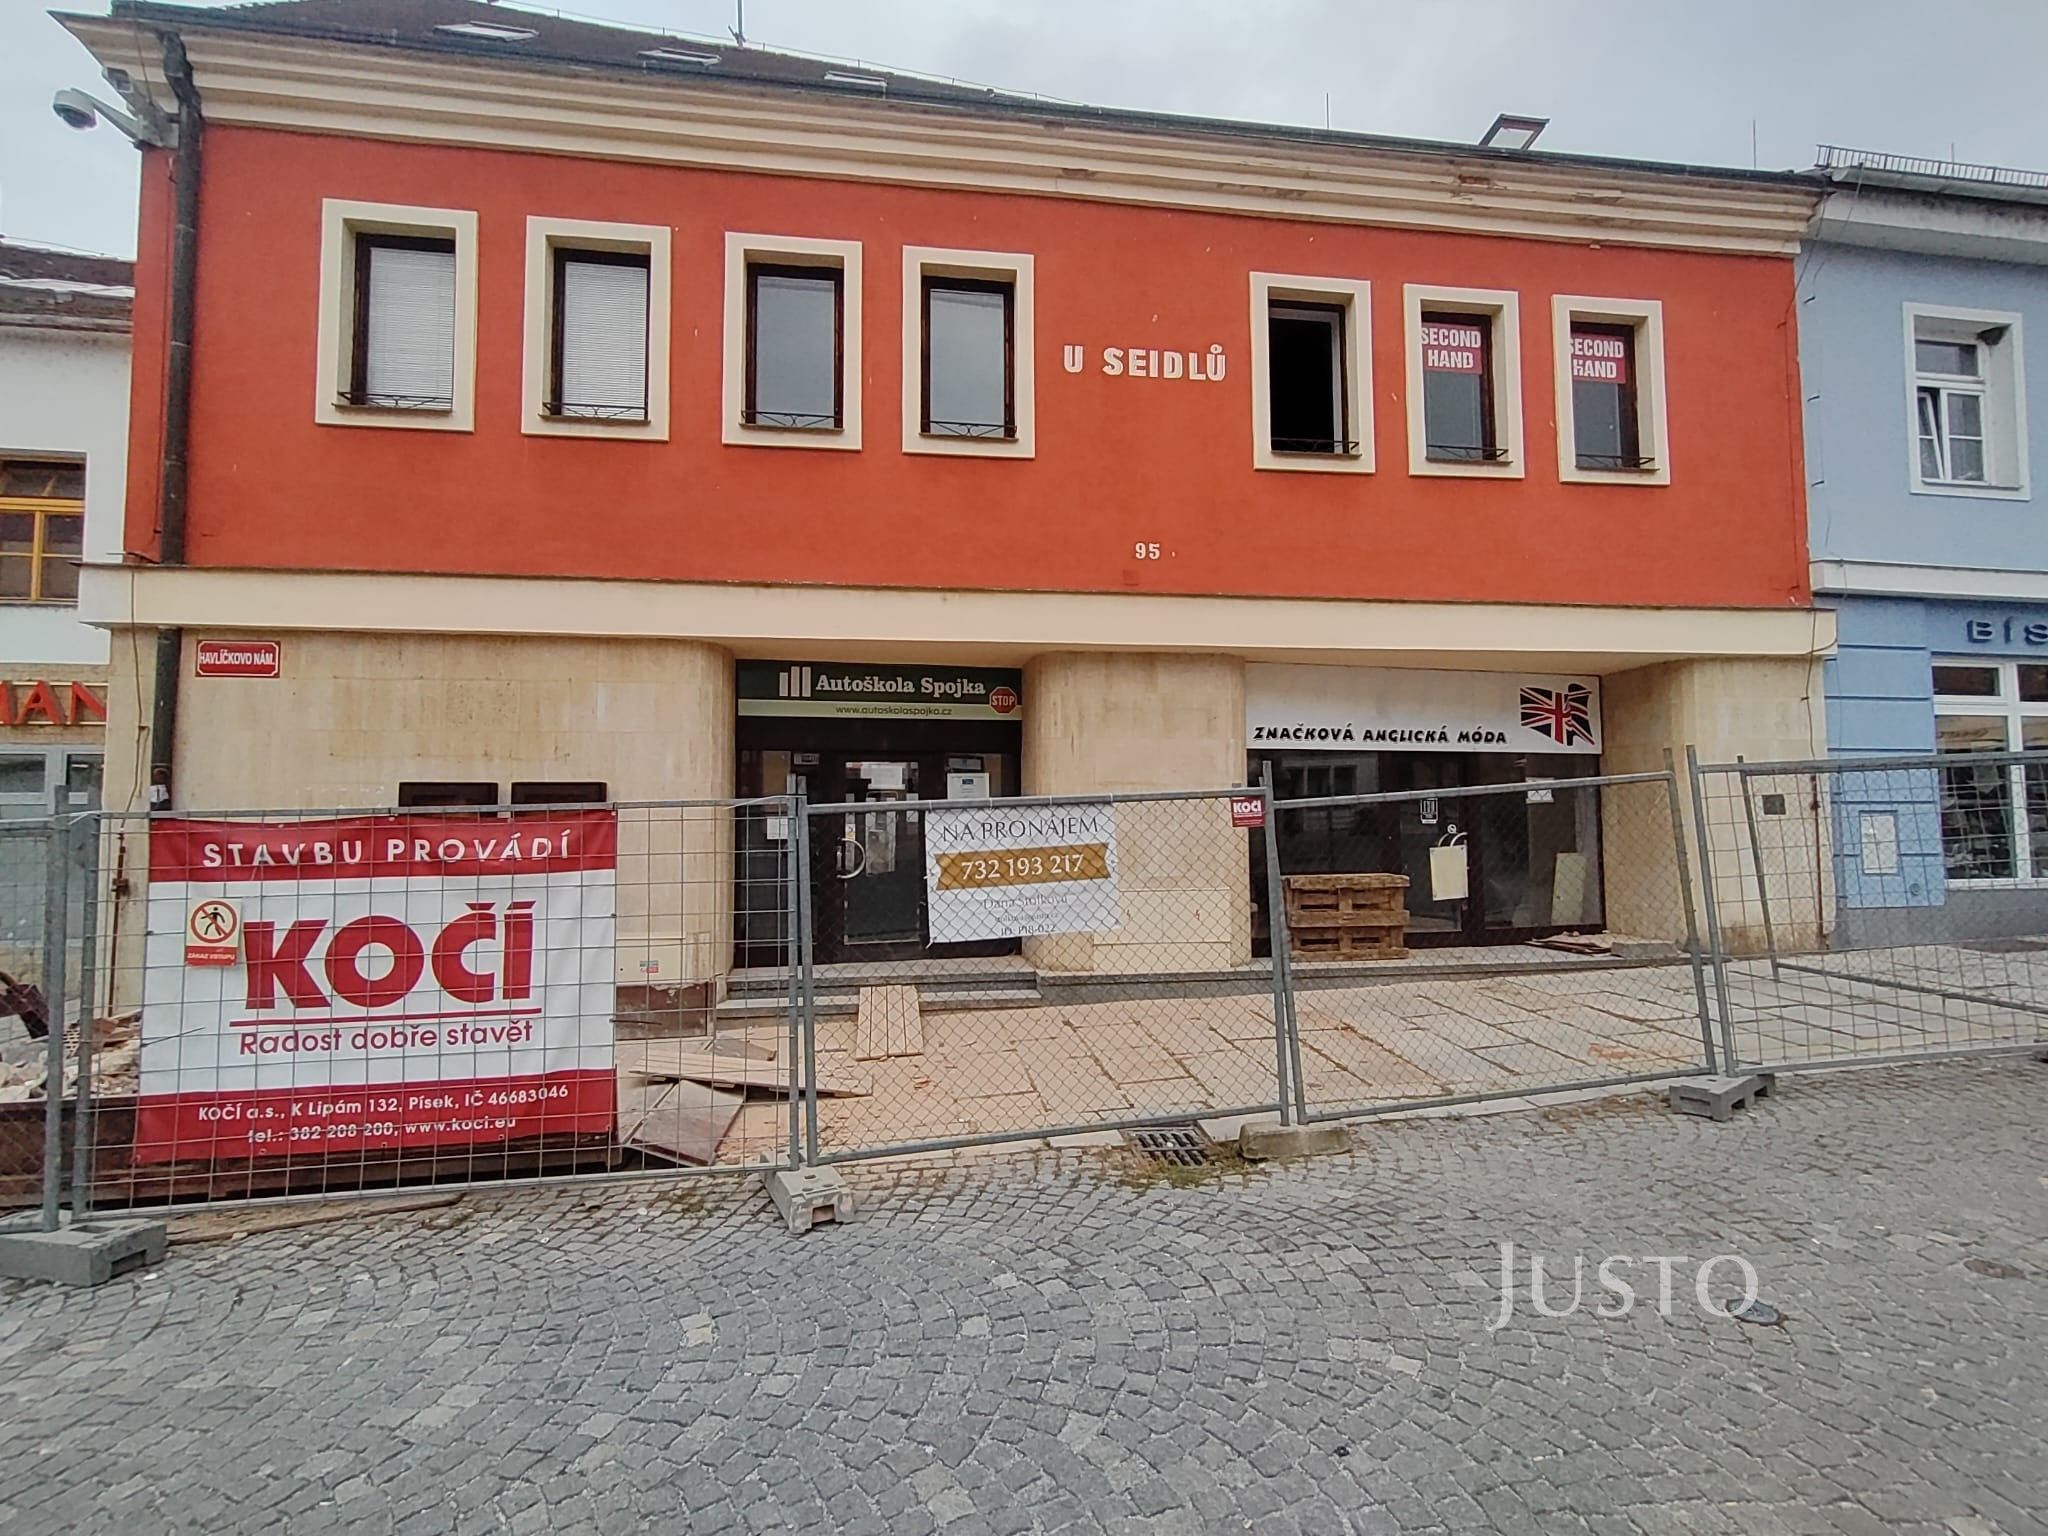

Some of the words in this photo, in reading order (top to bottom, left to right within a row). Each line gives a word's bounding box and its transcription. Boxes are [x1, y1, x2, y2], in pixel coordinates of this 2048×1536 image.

[1063, 345, 1084, 373] U
[1102, 343, 1226, 382] SEIDLŮ
[1427, 349, 1474, 369] HAND
[1573, 358, 1617, 379] HAND
[1135, 542, 1160, 560] 95
[199, 649, 252, 665] HAVLÍČKOVO
[253, 649, 275, 666] NÁM.
[816, 674, 915, 694] Autoškola
[920, 677, 986, 698] Spojka
[992, 695, 1015, 707] STOP
[1253, 722, 1355, 741] ZNAČKOVÁ
[1362, 724, 1449, 743] ANGLICKÁ
[1457, 726, 1507, 744] MÓDA
[943, 826, 975, 841] NA
[202, 840, 362, 867] STAVBU
[386, 828, 572, 863] PROVÁDÍ
[961, 859, 1001, 880] 732
[1006, 856, 1043, 877] 193
[1050, 854, 1084, 875] 217
[243, 900, 537, 1010] KOČÍ
[239, 1027, 342, 1055] Radost
[351, 1023, 438, 1050] dobře
[446, 1019, 533, 1046] stavět
[198, 1102, 242, 1121] KOČÍ
[246, 1107, 286, 1120] a.s.,
[291, 1103, 303, 1117] K
[308, 1100, 362, 1118] Lipám
[368, 1098, 402, 1113] 132,
[408, 1094, 460, 1110] Písek,
[464, 1090, 484, 1107] IČ
[488, 1085, 569, 1105] 46683046
[289, 1125, 321, 1141] 382
[404, 1115, 517, 1135] www.koci.eu
